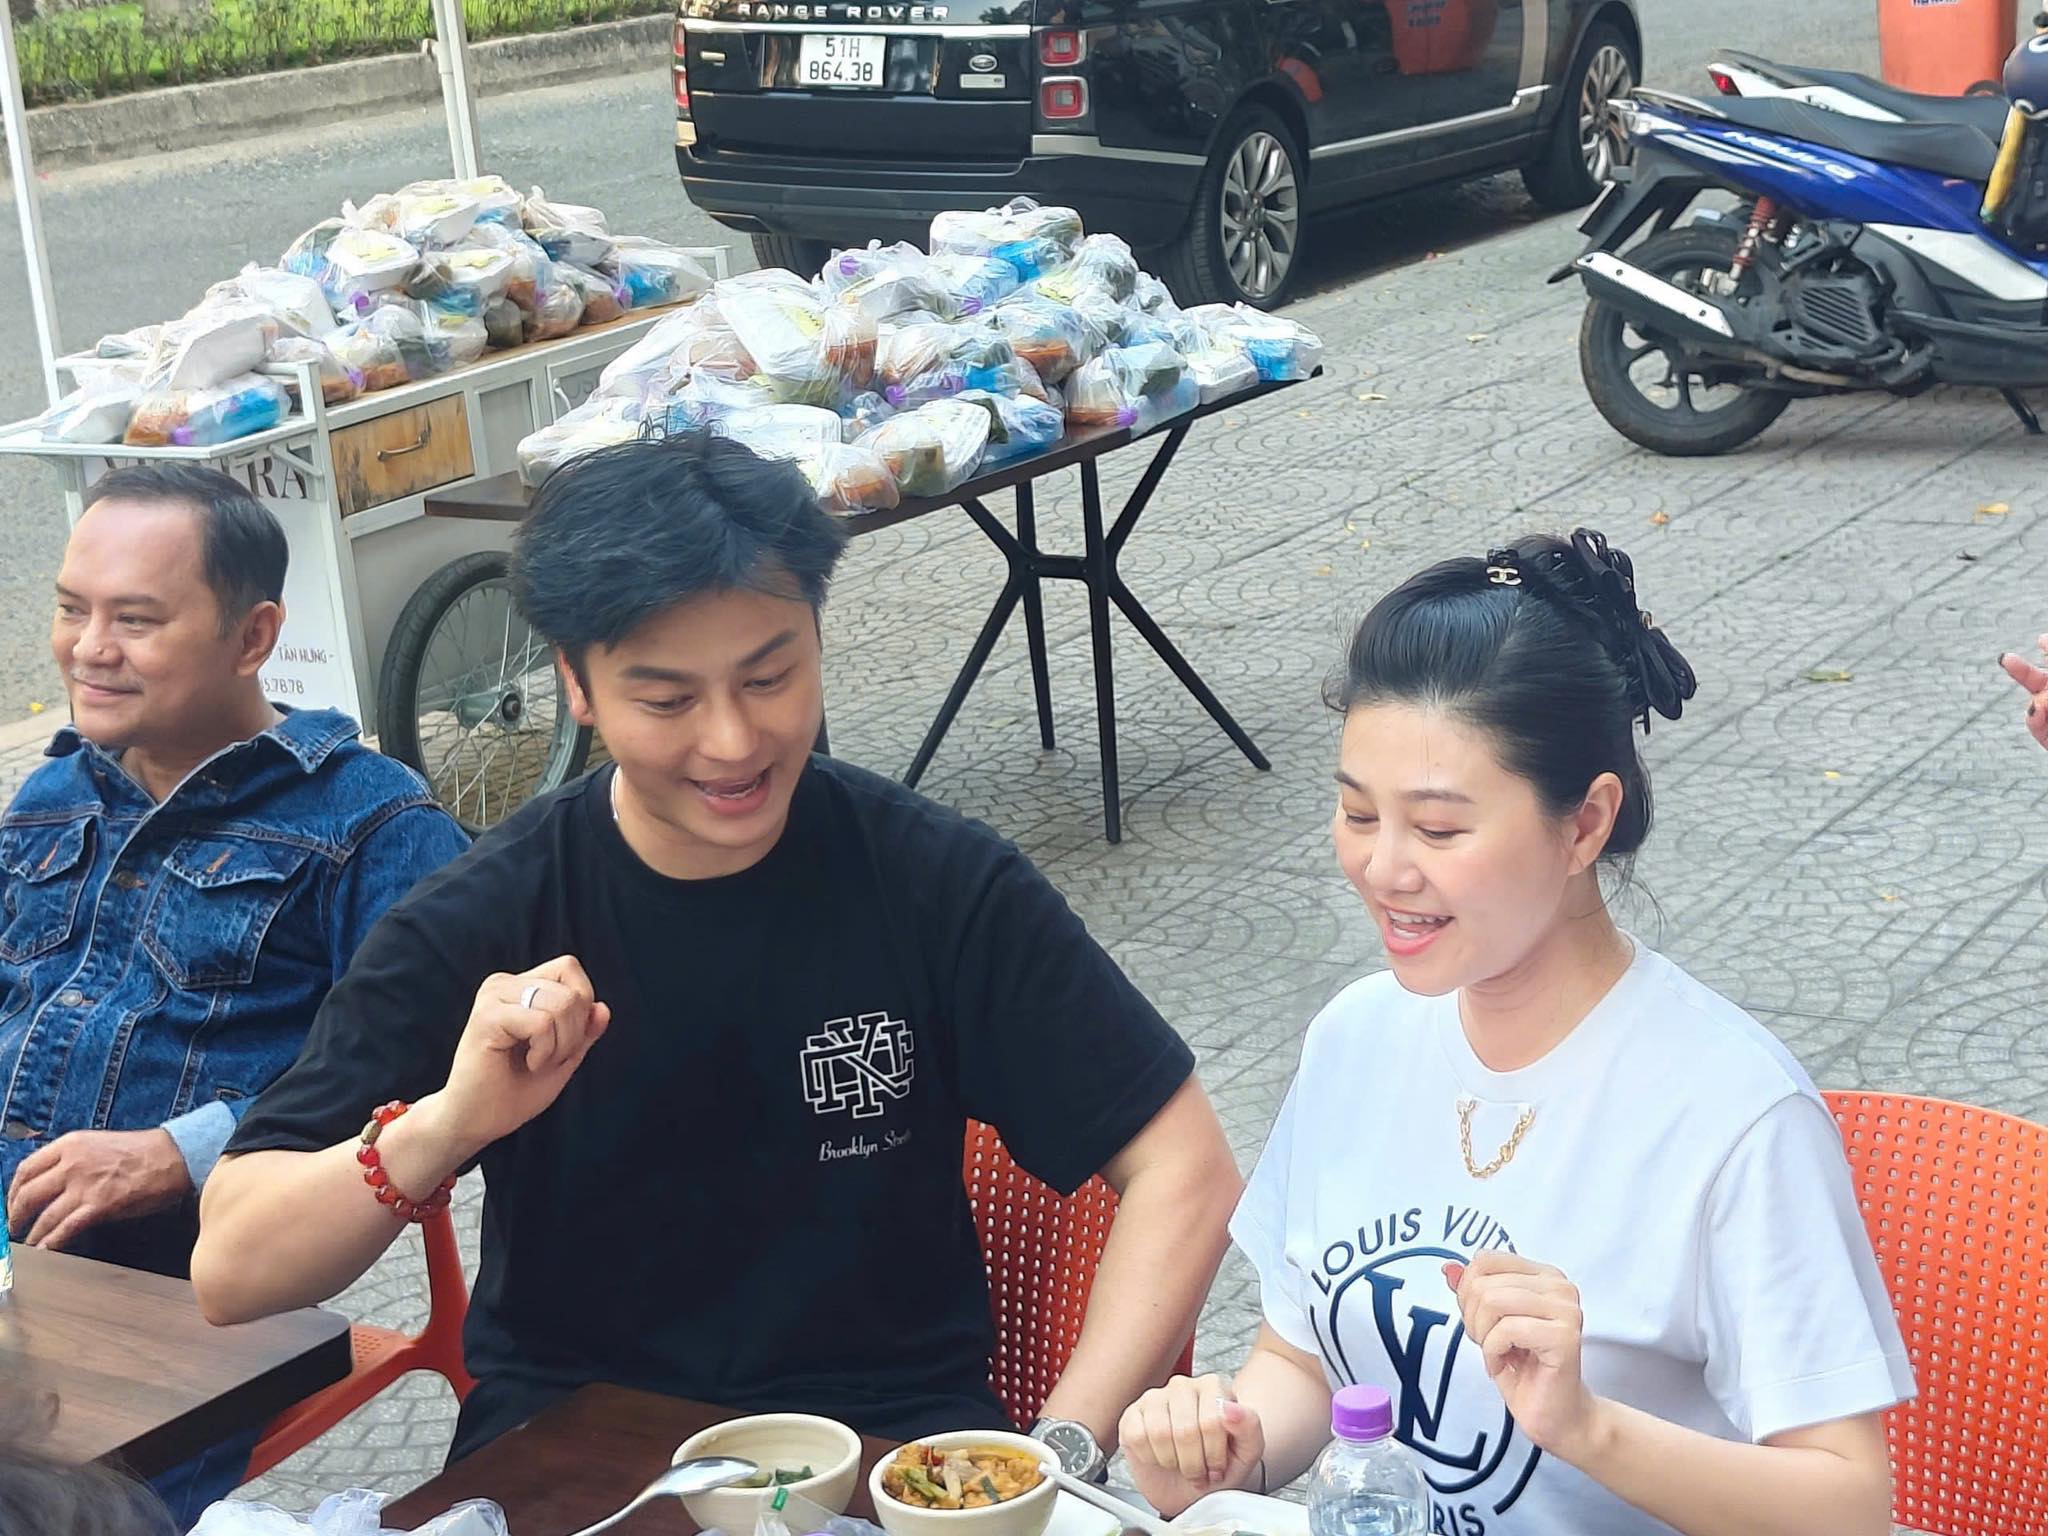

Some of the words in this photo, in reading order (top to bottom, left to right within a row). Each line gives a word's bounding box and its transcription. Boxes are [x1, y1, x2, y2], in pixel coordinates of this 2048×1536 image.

[738, 4, 828, 20] RANGE
[846, 5, 949, 19] ROVER
[825, 37, 860, 58] 51H
[809, 60, 873, 82] 864.38
[819, 1134, 878, 1162] Brooklyn
[1311, 1208, 1422, 1297] LOUIS
[1443, 1205, 1518, 1255] VUIT
[1431, 1500, 1485, 1536] RIS
